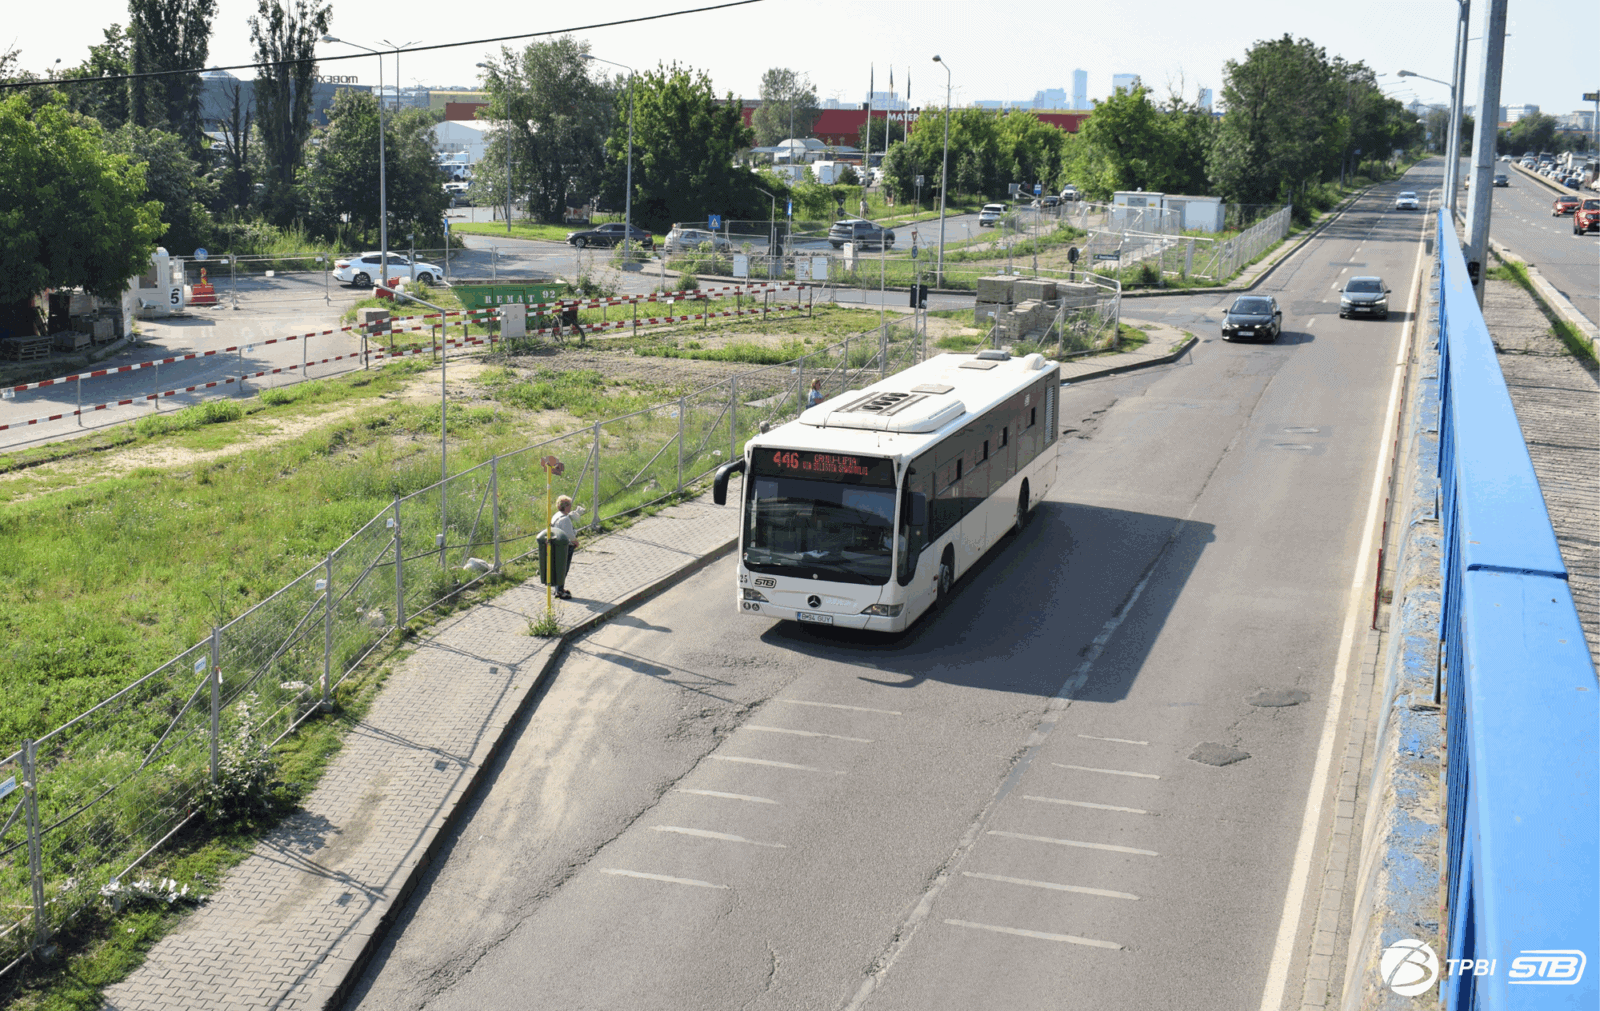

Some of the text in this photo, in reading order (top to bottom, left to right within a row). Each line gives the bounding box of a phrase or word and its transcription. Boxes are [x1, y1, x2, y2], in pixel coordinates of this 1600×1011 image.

[485, 290, 556, 304] REMAT 92
[773, 451, 799, 468] 446
[754, 576, 777, 588] STB
